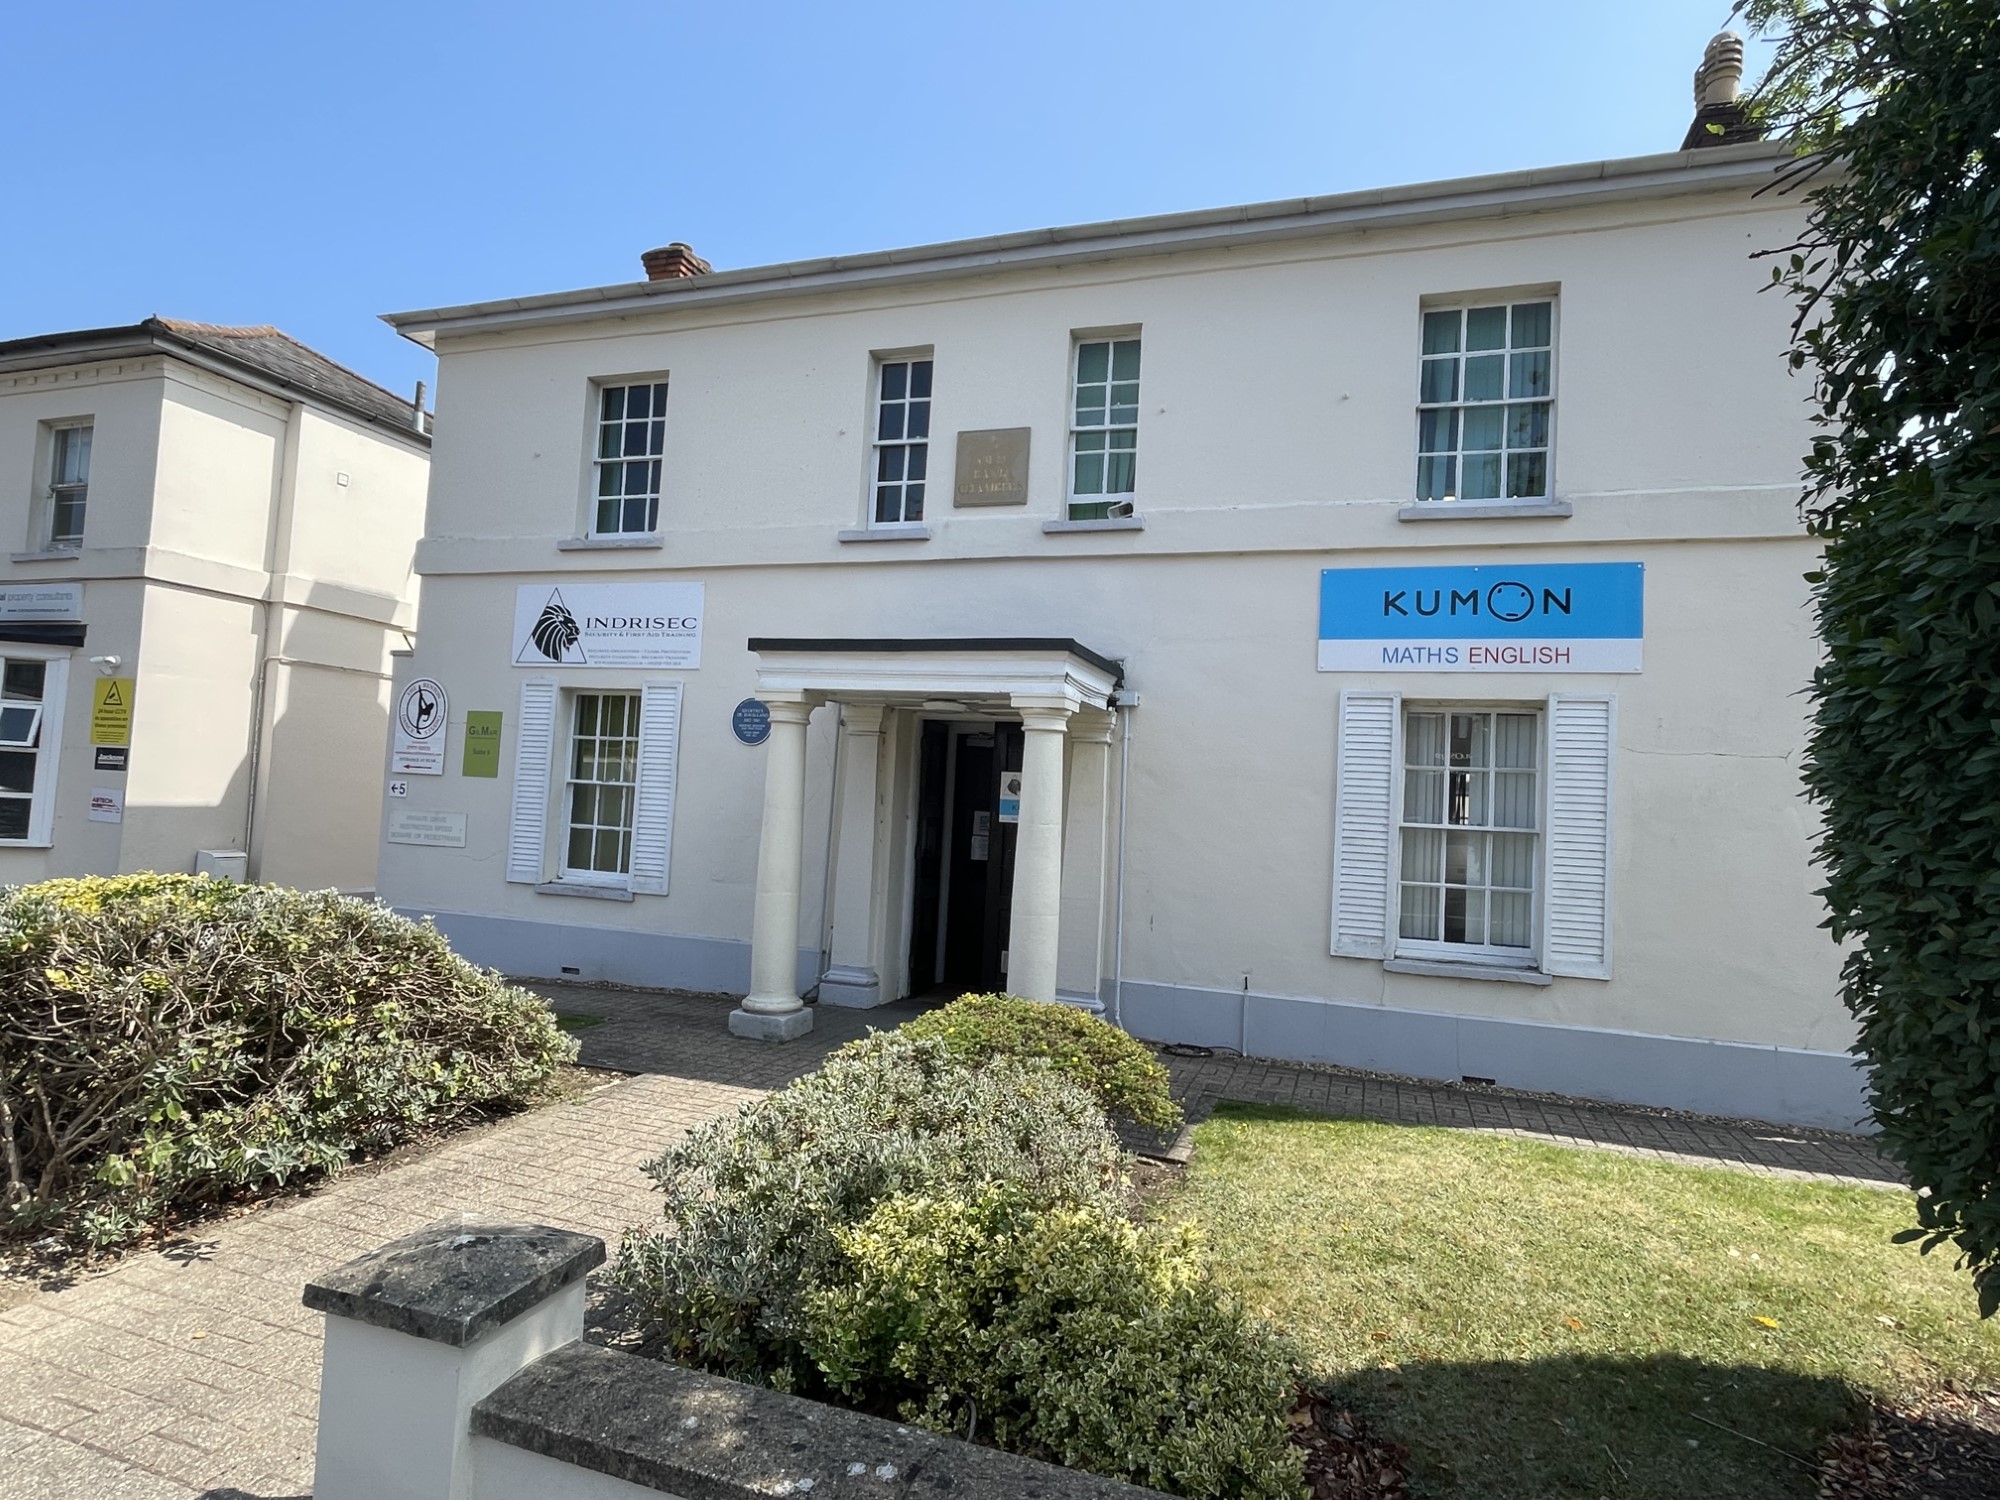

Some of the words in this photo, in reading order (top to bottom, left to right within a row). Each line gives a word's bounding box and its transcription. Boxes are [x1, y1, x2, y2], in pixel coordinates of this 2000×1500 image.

[1383, 581, 1572, 622] KUMON
[586, 617, 698, 630] INDRISEC
[1382, 646, 1459, 665] MATHS
[1468, 646, 1571, 665] ENGLISH
[398, 783, 406, 795] 5
